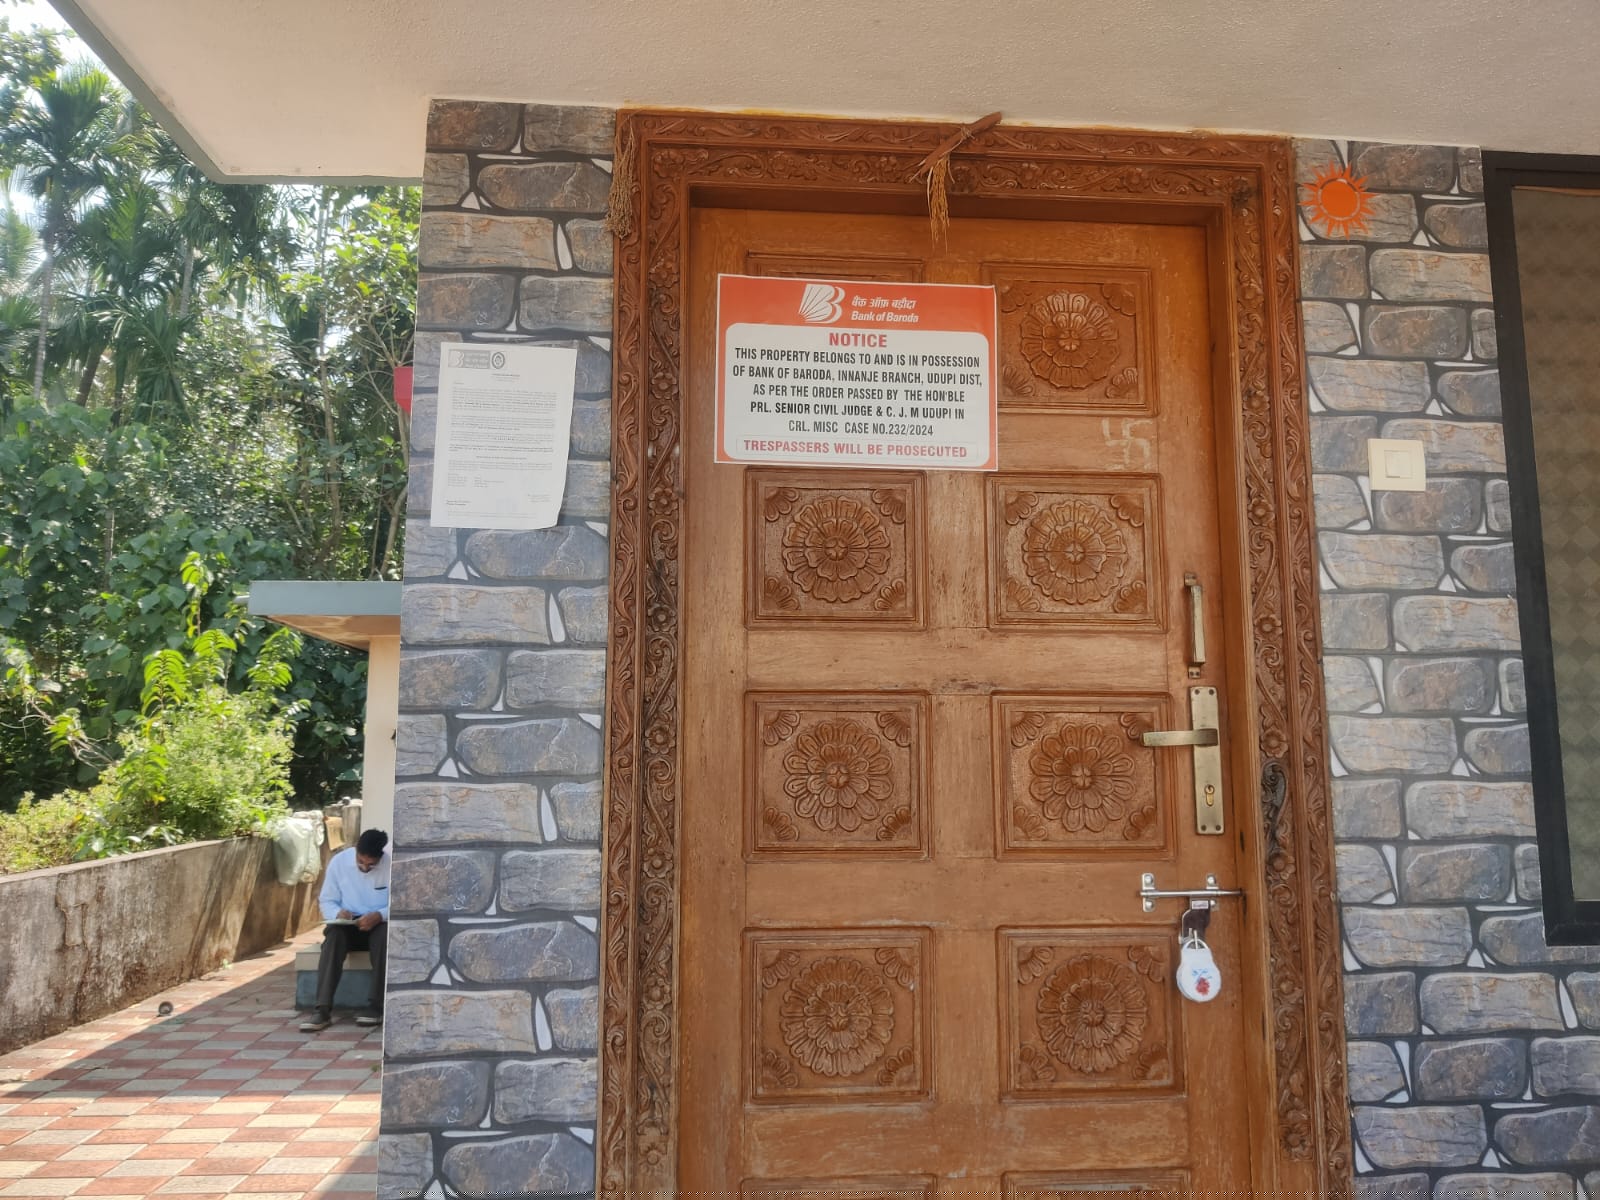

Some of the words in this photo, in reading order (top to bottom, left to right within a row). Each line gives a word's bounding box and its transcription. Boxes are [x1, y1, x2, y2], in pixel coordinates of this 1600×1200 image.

[851, 312, 874, 321] Bank
[876, 312, 885, 322] of
[886, 313, 919, 322] Baroda
[829, 332, 887, 347] NOTICE
[735, 348, 757, 359] THIS
[760, 349, 810, 362] PROPERTY
[814, 352, 856, 364] BELONGS
[859, 354, 871, 364] TO
[874, 354, 893, 365] AND
[897, 355, 905, 365] IS
[909, 355, 918, 366] IN
[922, 355, 980, 368] POSSESSION
[733, 365, 745, 376] OF
[749, 366, 774, 378] BANK
[777, 368, 790, 378] OF
[793, 369, 835, 382] BARODA,
[838, 370, 878, 383] INNANJE
[882, 372, 924, 385] BRANCH,
[927, 373, 956, 384] UDUPI
[959, 374, 982, 387] DIST,
[753, 384, 765, 395] AS
[769, 385, 787, 396] PER
[791, 386, 809, 397] THE
[812, 386, 844, 399] ORDER
[847, 388, 883, 400] PASSED
[887, 389, 898, 400] BY
[904, 390, 922, 401] THE
[926, 391, 965, 402] HON'BLE
[750, 402, 771, 412] PRL.
[775, 403, 810, 414] SENIOR
[814, 404, 838, 415] CIVIL
[841, 405, 872, 416] JUDGE
[876, 406, 882, 416] &
[886, 406, 895, 417] C.
[899, 407, 907, 418] J.
[910, 408, 919, 418] M
[922, 408, 951, 419] UDUPI
[955, 408, 964, 419] IN
[789, 420, 810, 432] CRL.
[814, 421, 838, 433] MISC
[844, 422, 869, 434] CASE
[873, 423, 934, 436] NO.232/2024
[744, 440, 829, 453] TRESPASSERS
[834, 443, 863, 455] WILL
[868, 444, 883, 454] BE
[888, 445, 967, 457] PROSECUTED
